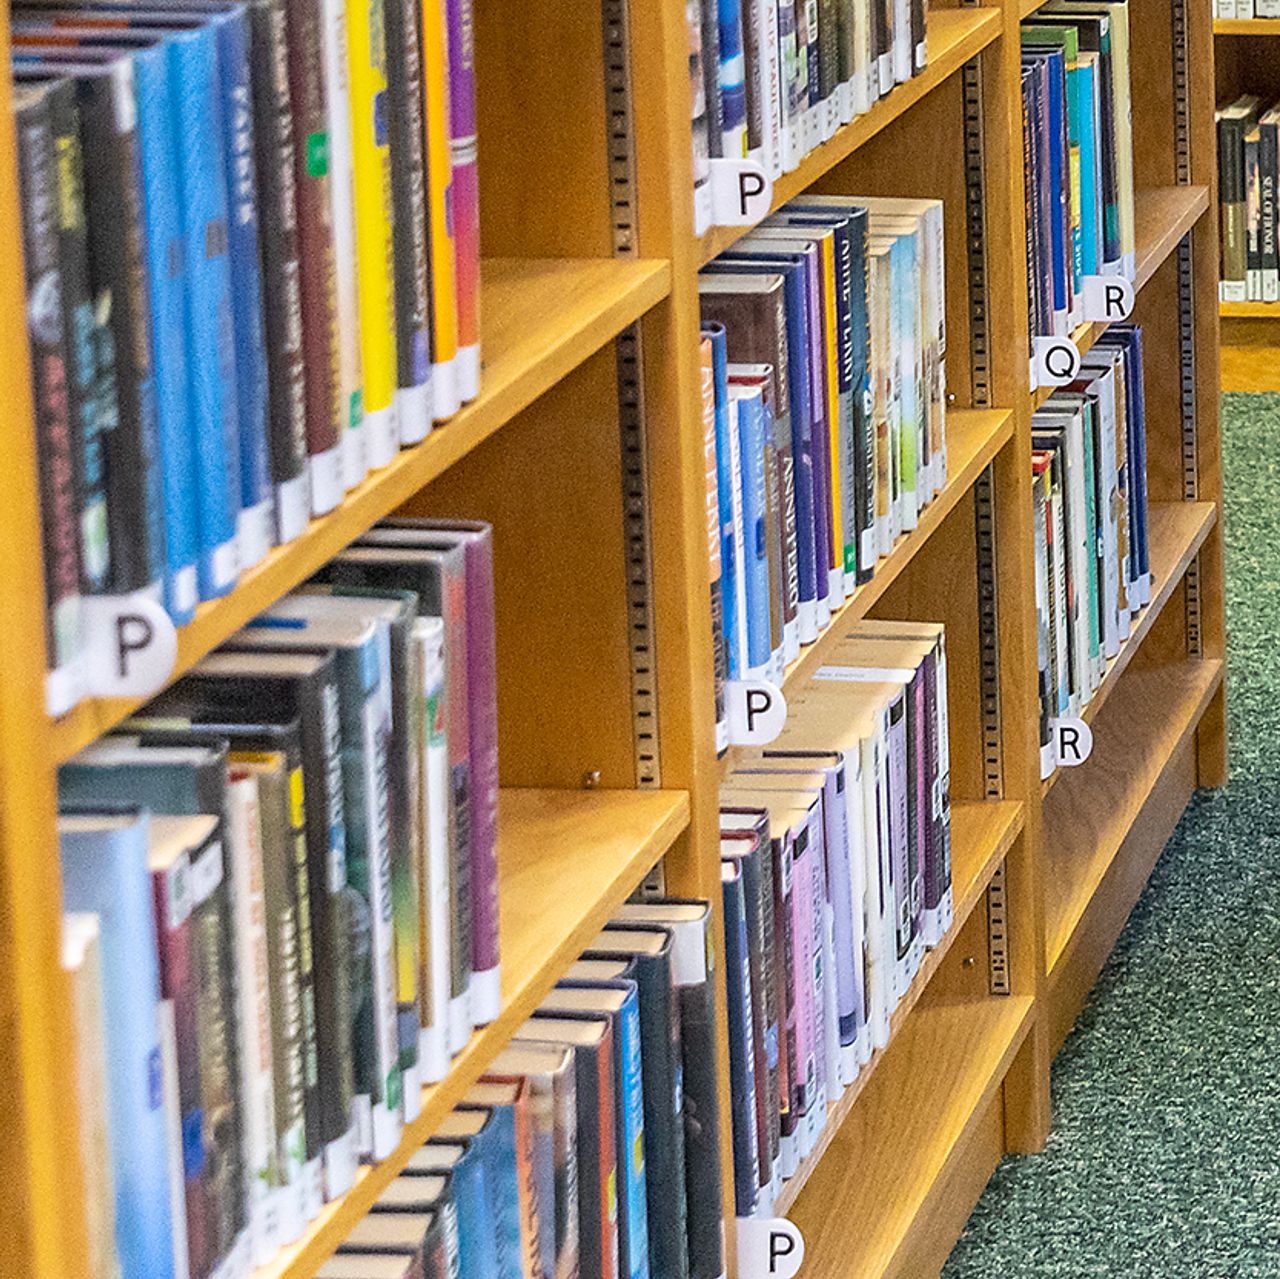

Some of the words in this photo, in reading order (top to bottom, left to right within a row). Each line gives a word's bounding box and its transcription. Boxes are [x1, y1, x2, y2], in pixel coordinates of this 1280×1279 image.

[767, 55, 780, 146] PAULTRE
[737, 172, 766, 216] P
[1263, 176, 1274, 199] SEAL
[1263, 212, 1274, 254] HONOR
[1105, 286, 1126, 317] R
[1044, 347, 1075, 379] Q
[701, 366, 719, 464] ANNE
[783, 456, 798, 527] ANNE
[703, 468, 722, 564] PERRY
[783, 531, 798, 610] PERRY
[117, 614, 154, 677] P
[745, 691, 772, 732] P
[1059, 727, 1081, 760] R
[768, 1231, 796, 1273] P
